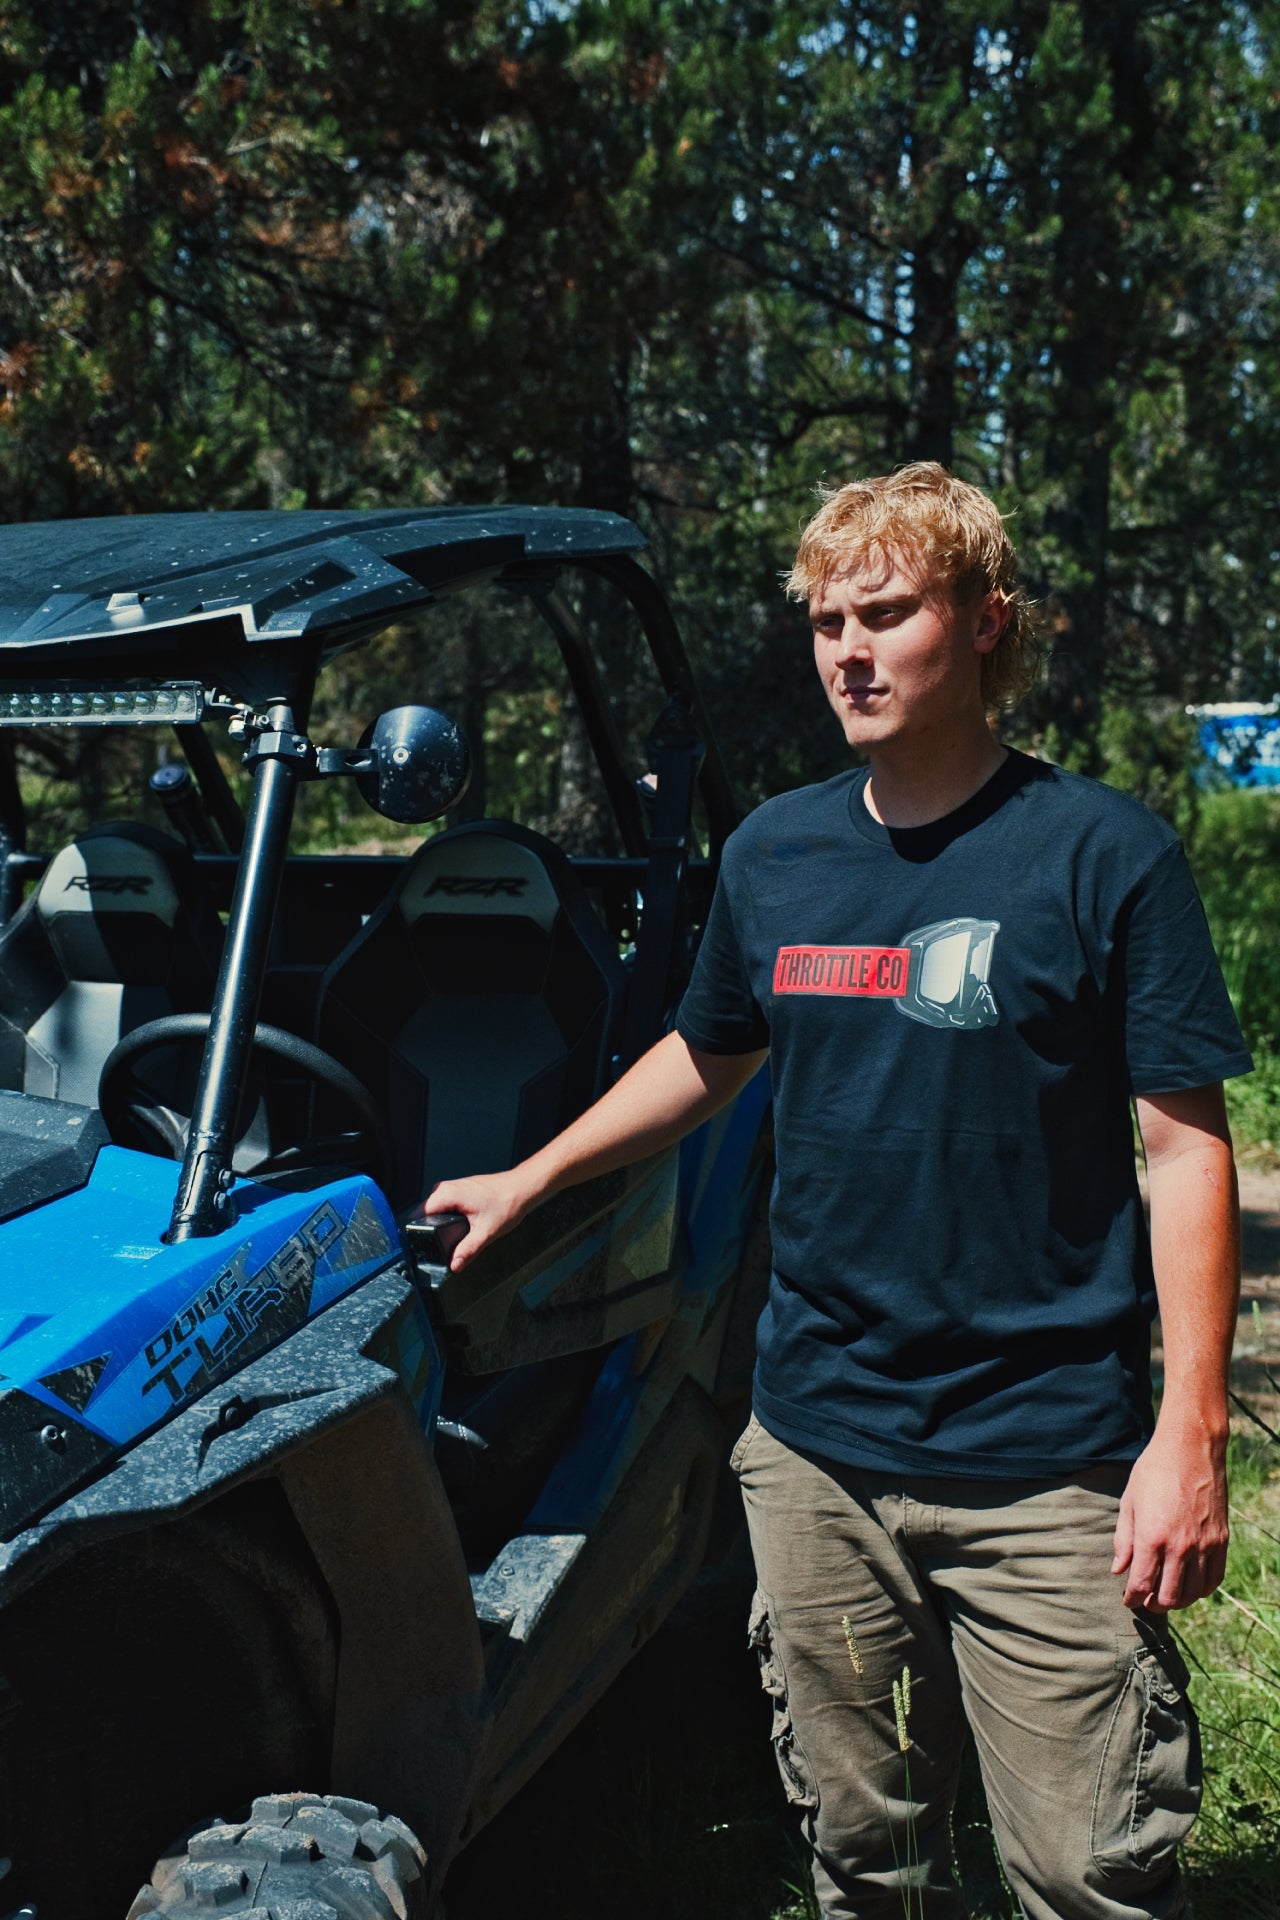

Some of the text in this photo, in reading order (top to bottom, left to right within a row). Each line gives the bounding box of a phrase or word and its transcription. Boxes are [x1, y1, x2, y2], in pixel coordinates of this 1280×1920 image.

[64, 875, 154, 895] RZR
[423, 876, 528, 897] RZR
[779, 953, 903, 990] THROTTLE CO
[141, 1200, 347, 1405] TURBO
[144, 1268, 239, 1368] DOHC
